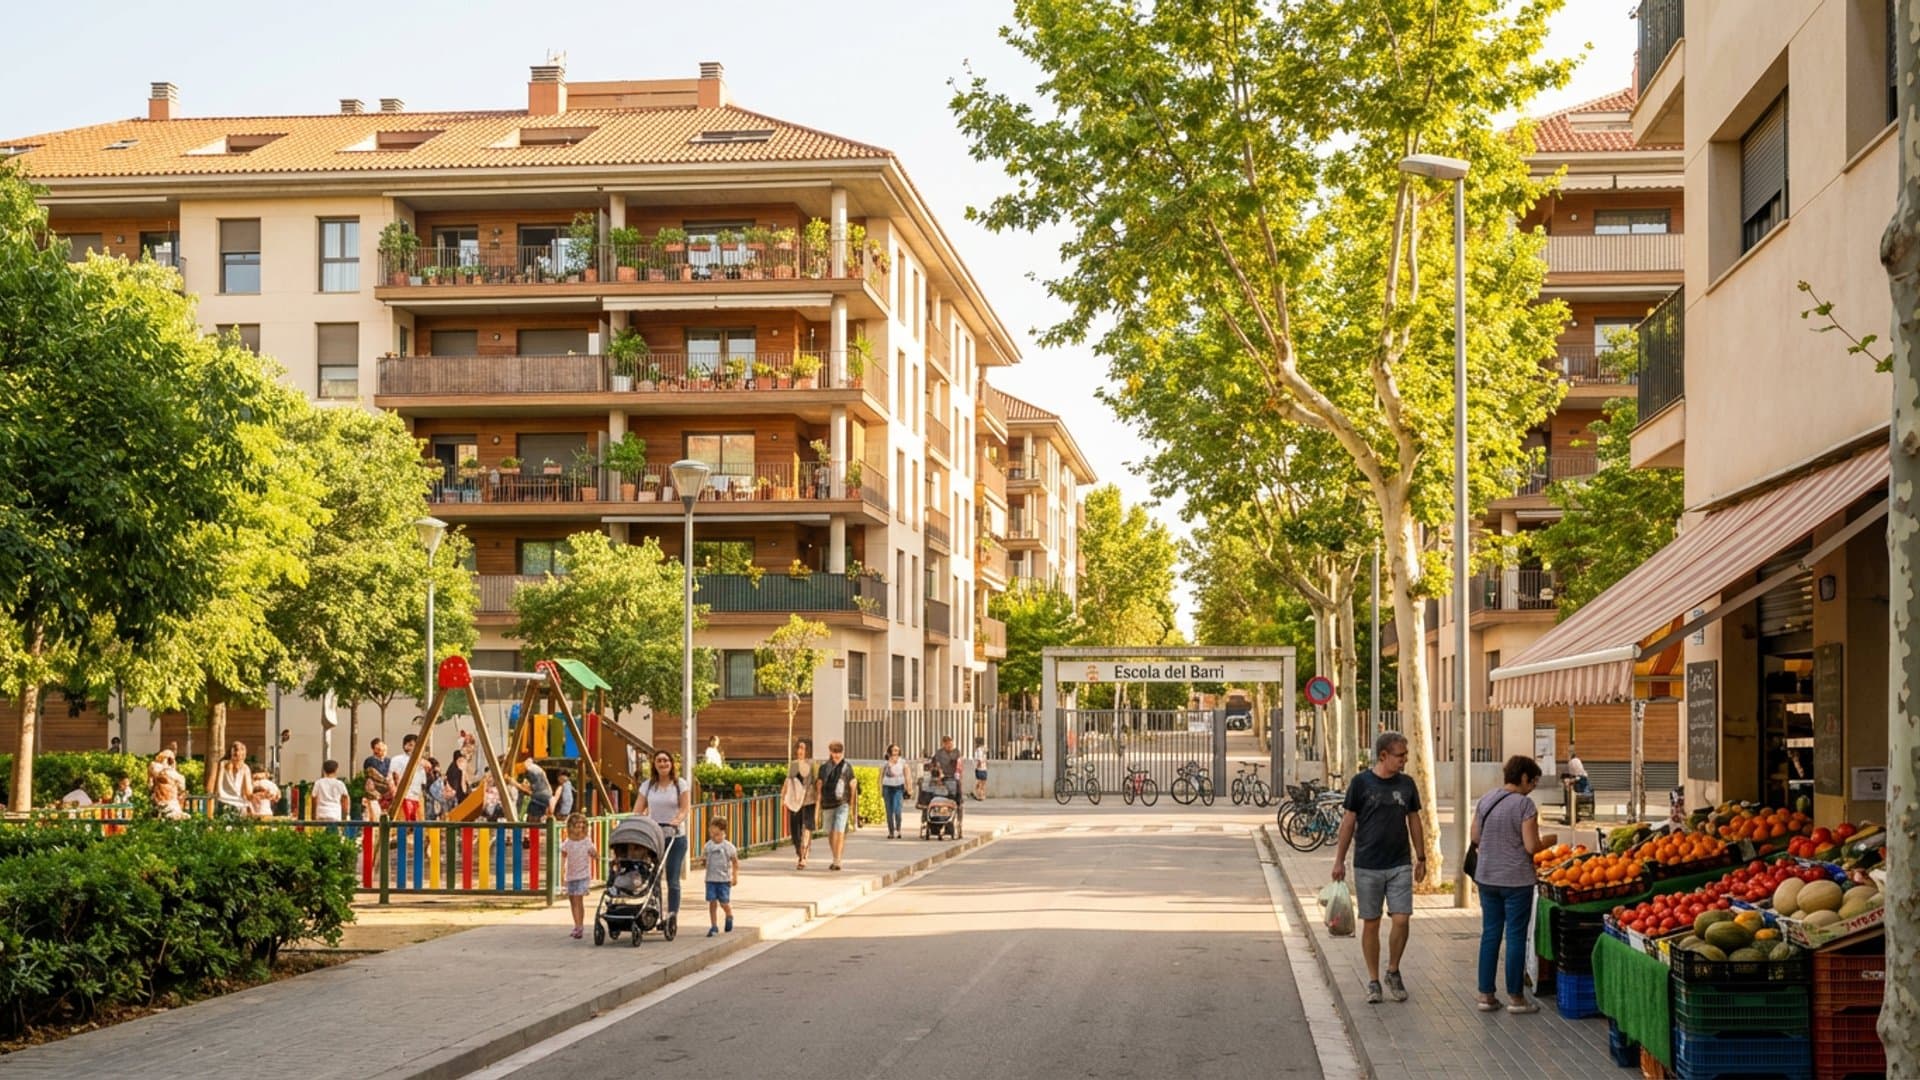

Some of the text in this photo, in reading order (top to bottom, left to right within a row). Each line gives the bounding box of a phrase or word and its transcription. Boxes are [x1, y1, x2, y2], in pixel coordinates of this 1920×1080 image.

[1115, 665, 1224, 679] Escola del Barri
